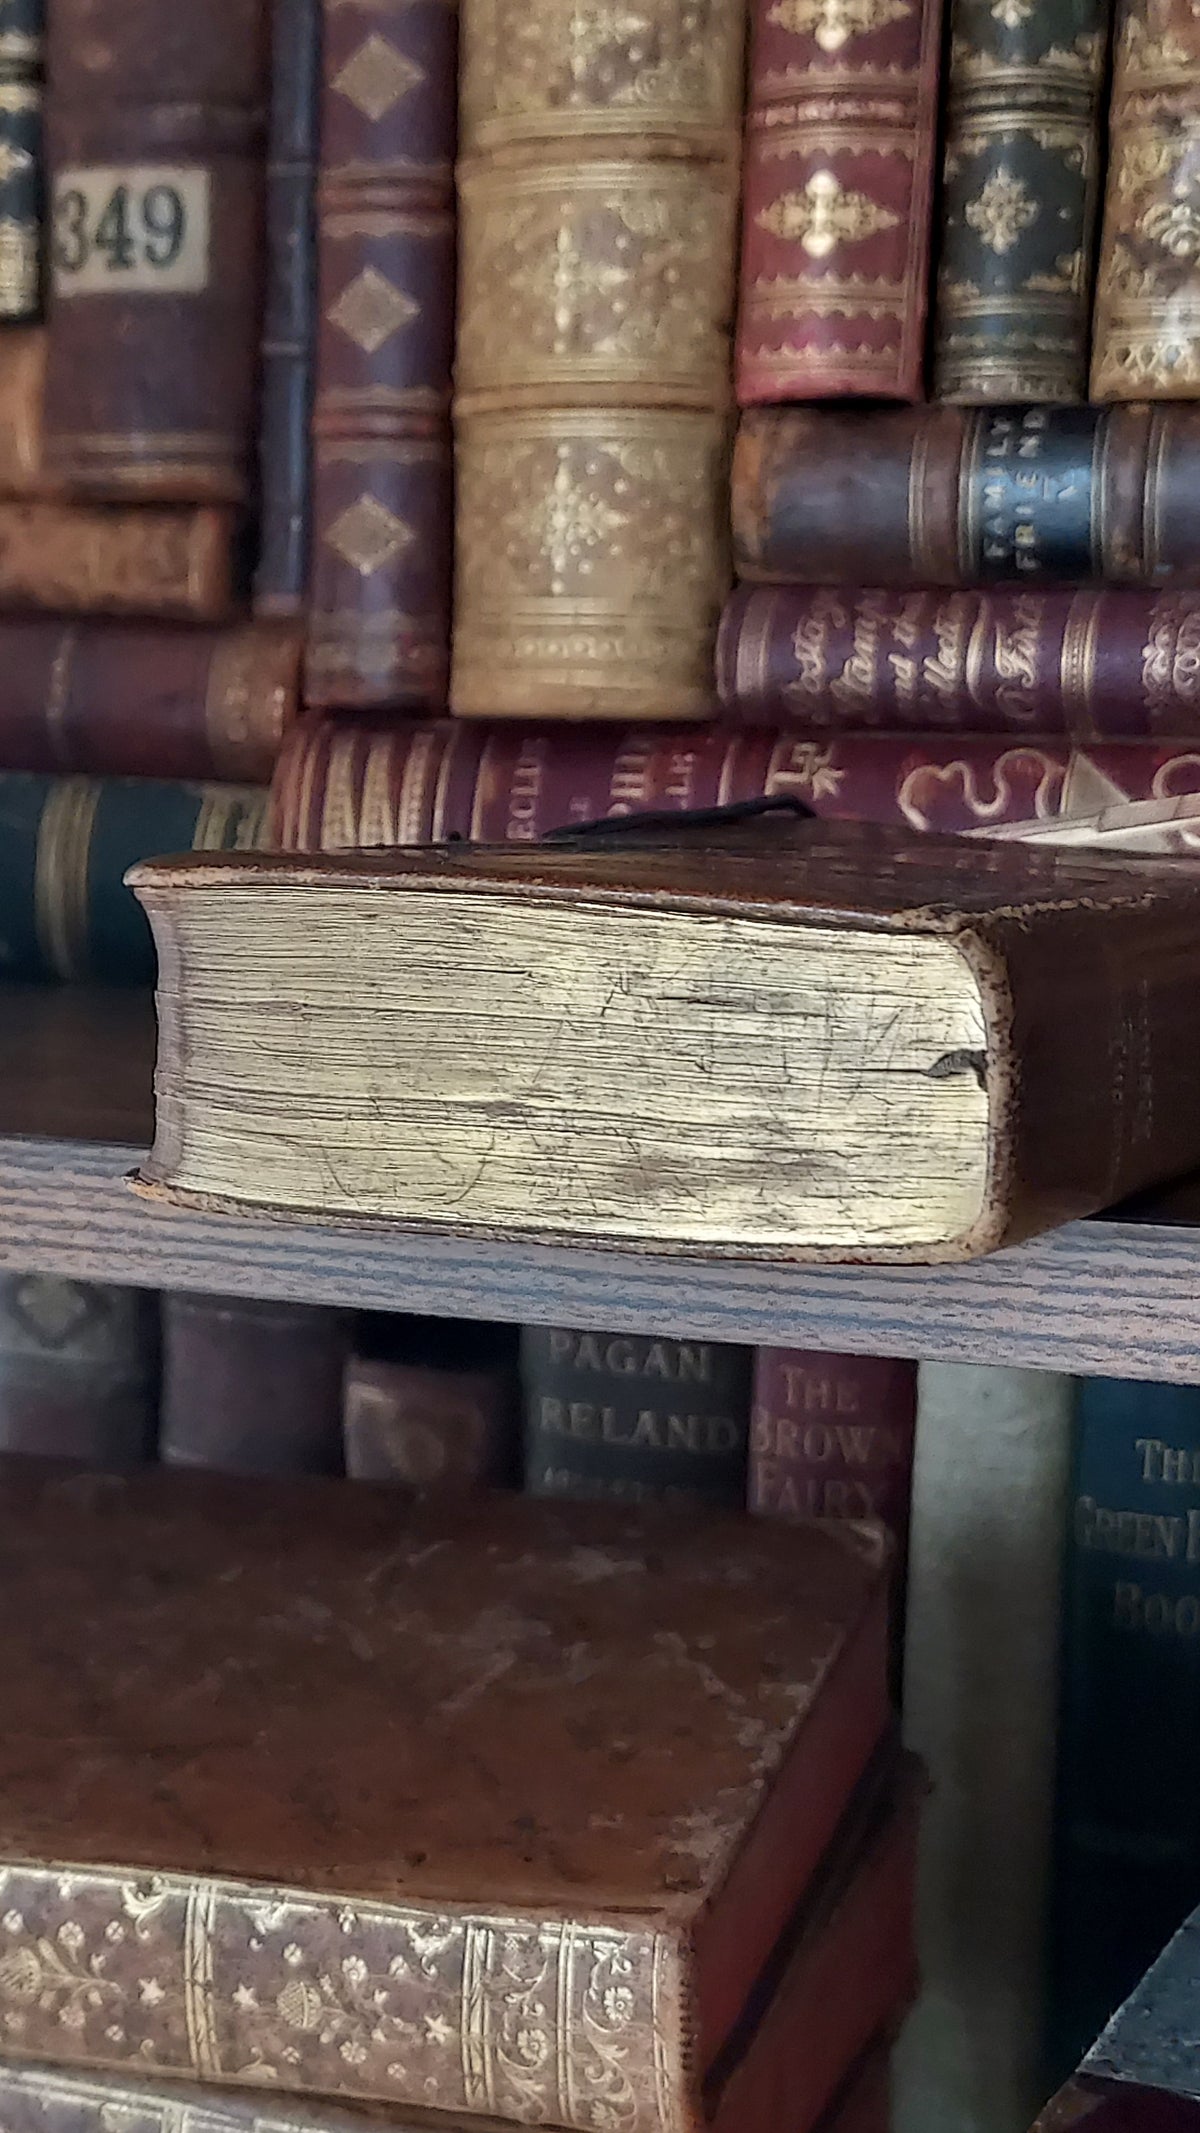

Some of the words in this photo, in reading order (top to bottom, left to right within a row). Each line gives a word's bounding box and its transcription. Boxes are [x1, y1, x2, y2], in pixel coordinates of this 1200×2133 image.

[55, 184, 185, 273] 349
[984, 417, 1013, 560] FAMILY
[1014, 410, 1048, 574] FRIEND
[548, 1328, 710, 1382] PAGAN
